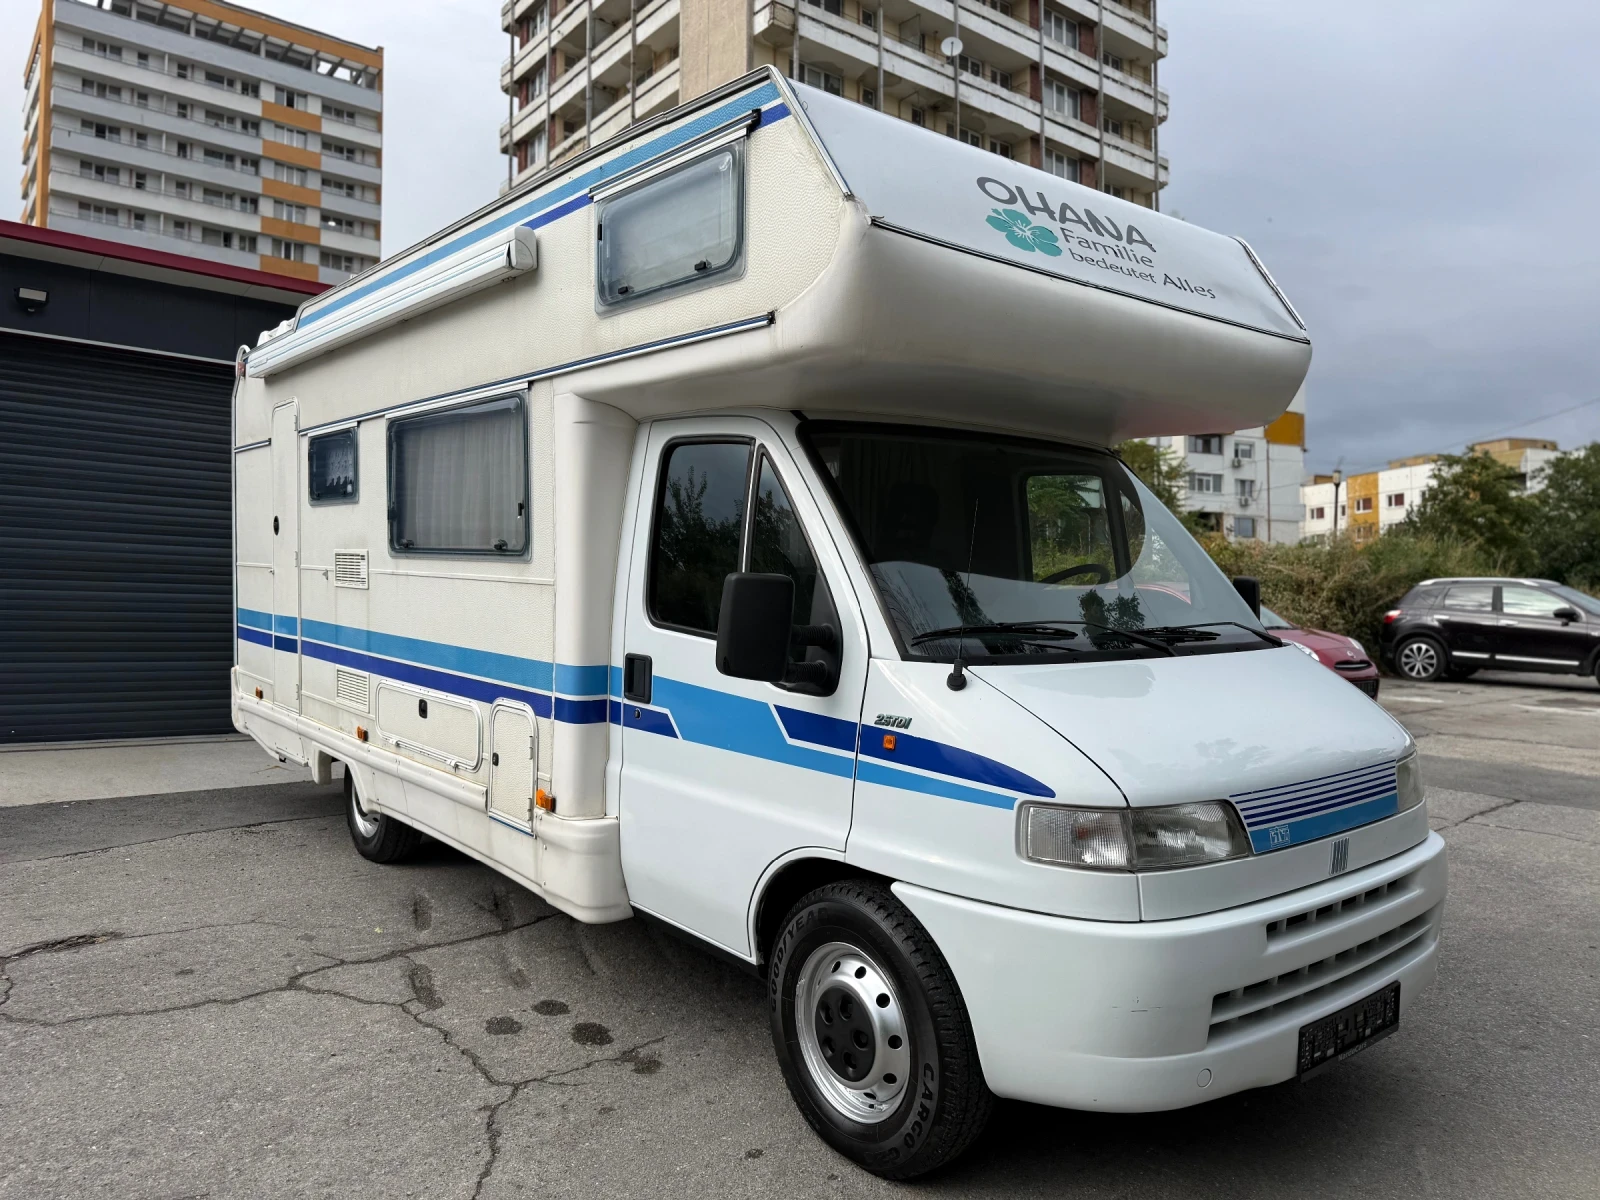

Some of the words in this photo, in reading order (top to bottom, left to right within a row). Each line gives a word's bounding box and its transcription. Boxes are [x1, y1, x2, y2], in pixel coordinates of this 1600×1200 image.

[976, 176, 1157, 252] OHANA
[1059, 227, 1155, 268] Familie
[1068, 248, 1157, 284] bedeutet
[1163, 273, 1216, 300] Alles
[903, 1062, 935, 1149] CARGO
